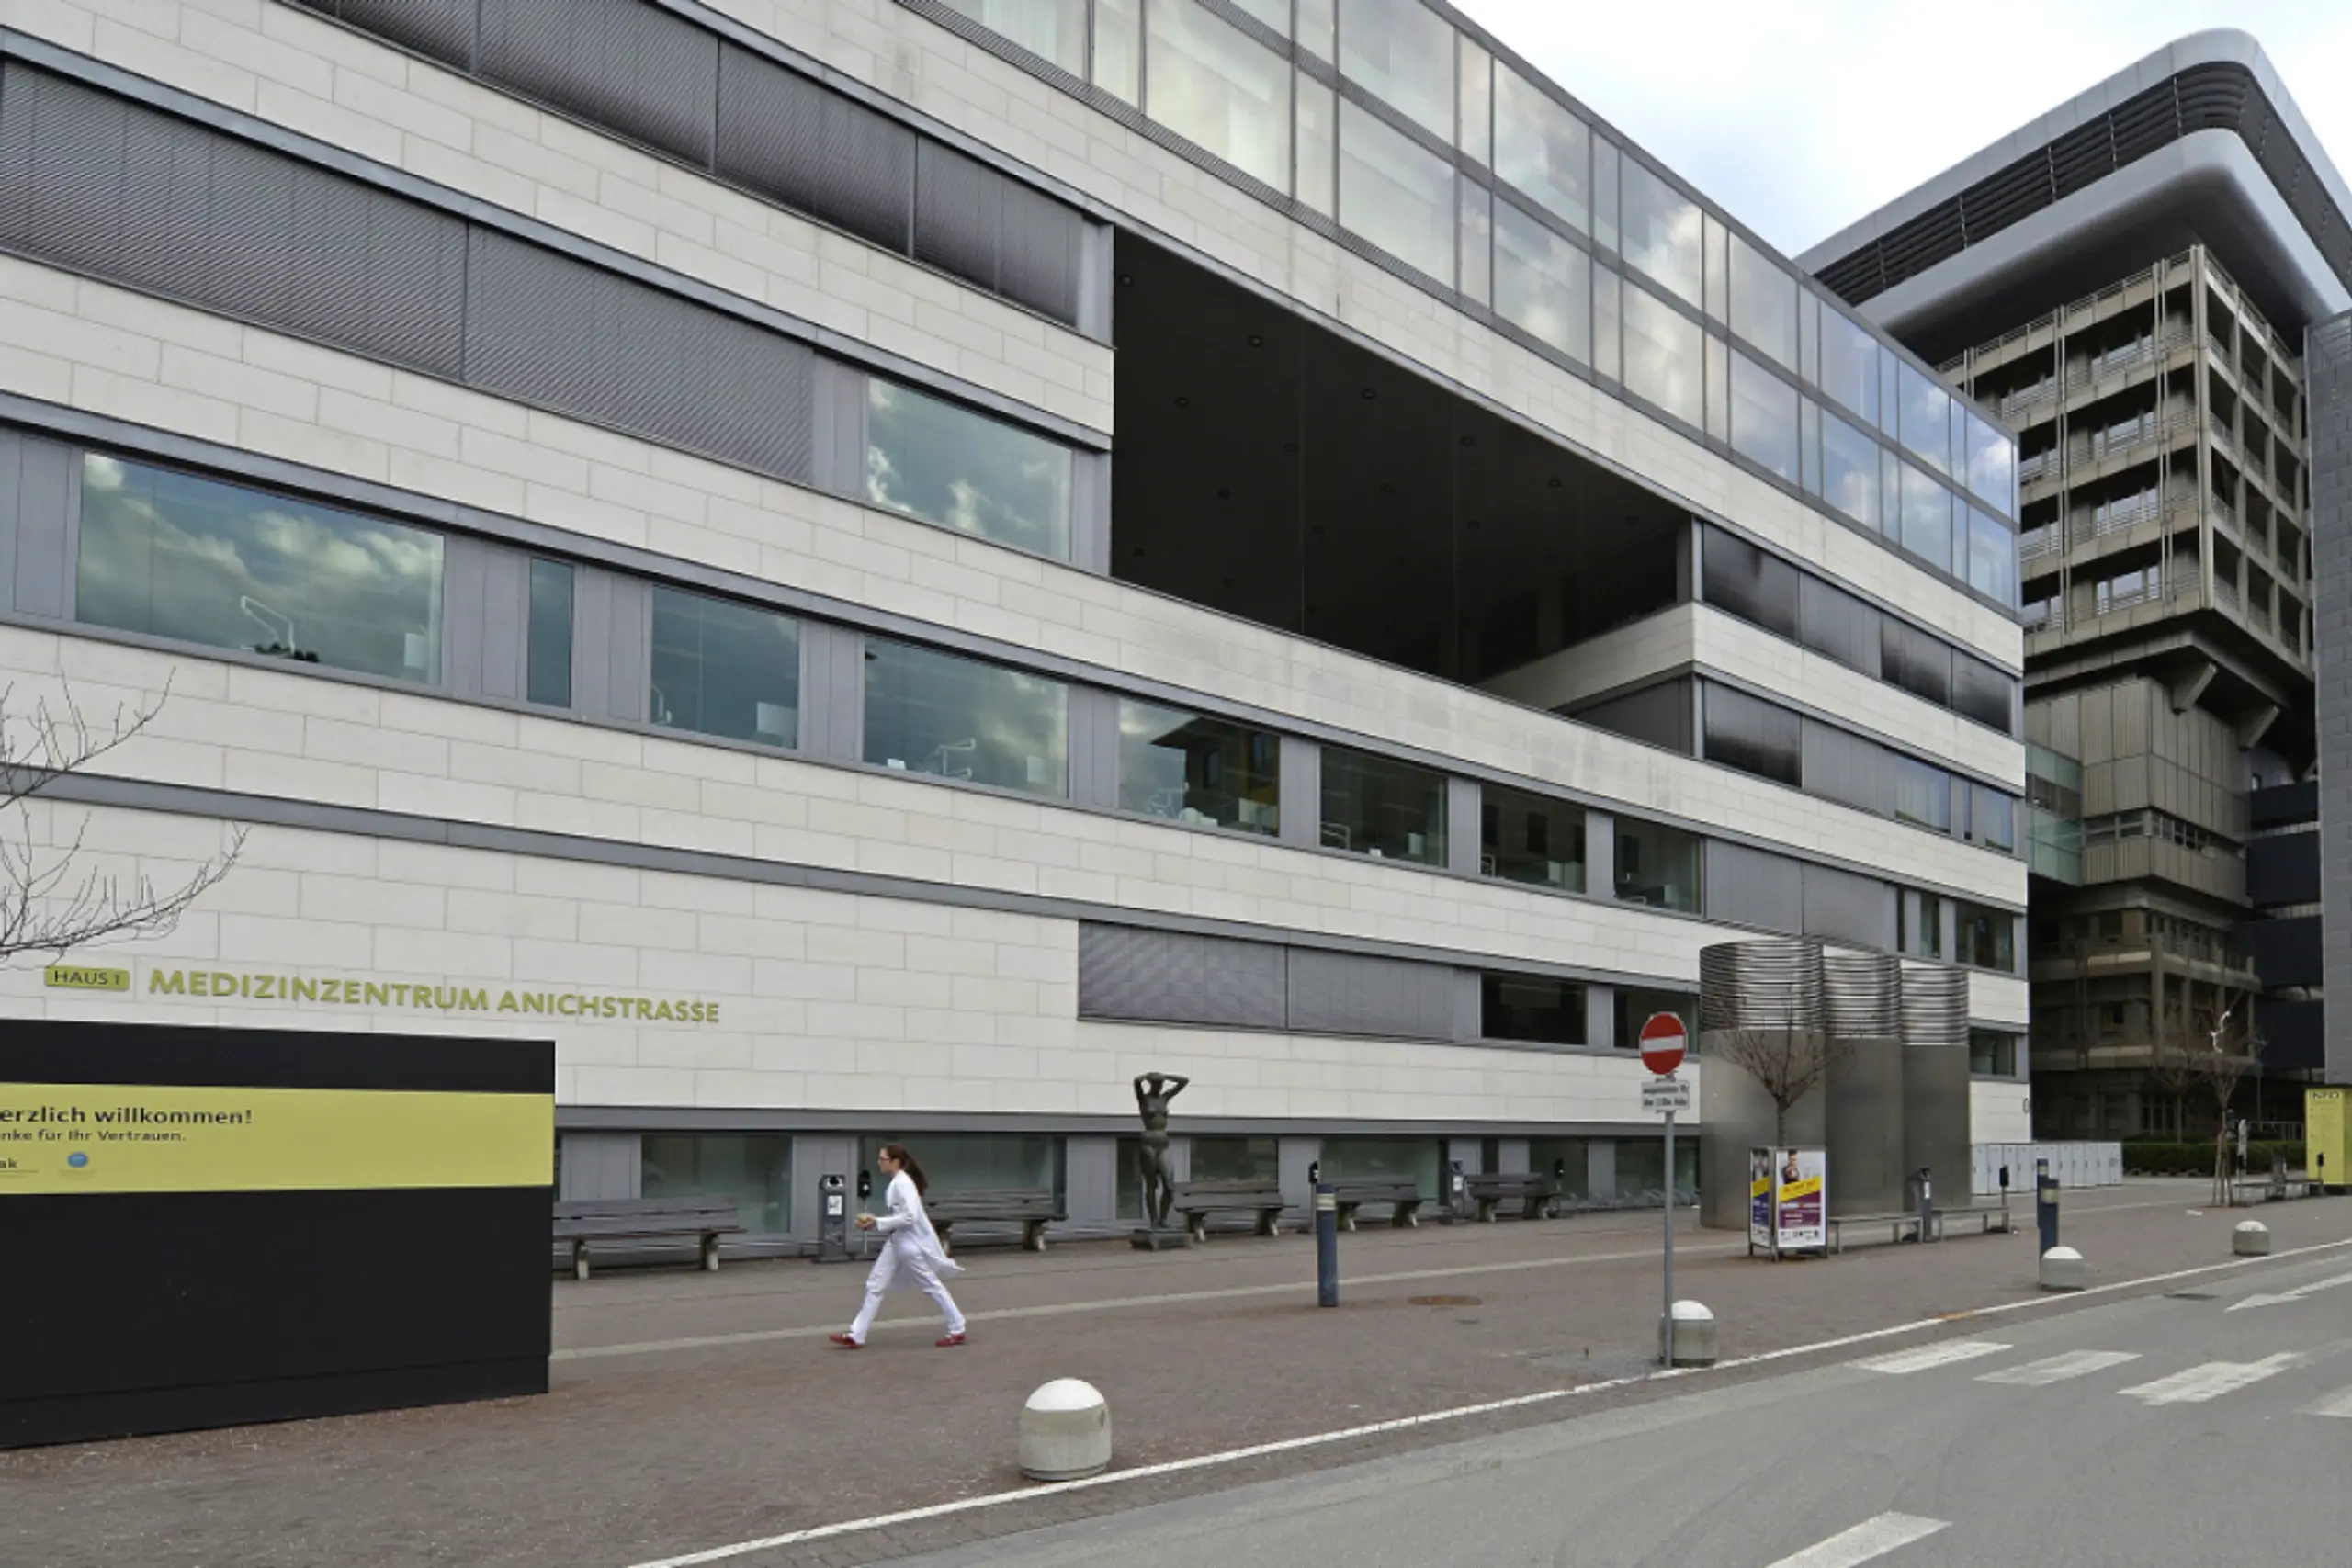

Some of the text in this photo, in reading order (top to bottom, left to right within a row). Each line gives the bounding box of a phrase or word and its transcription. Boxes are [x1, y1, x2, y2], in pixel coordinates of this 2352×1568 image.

[53, 970, 121, 986] HAUS 1
[148, 969, 721, 1023] MEDIZINZENTRUM ANICHSTRASSE
[94, 1107, 253, 1124] willkommen!
[38, 1129, 62, 1142] für
[68, 1130, 92, 1142] Ihr
[97, 1130, 186, 1142] Vertrauen.
